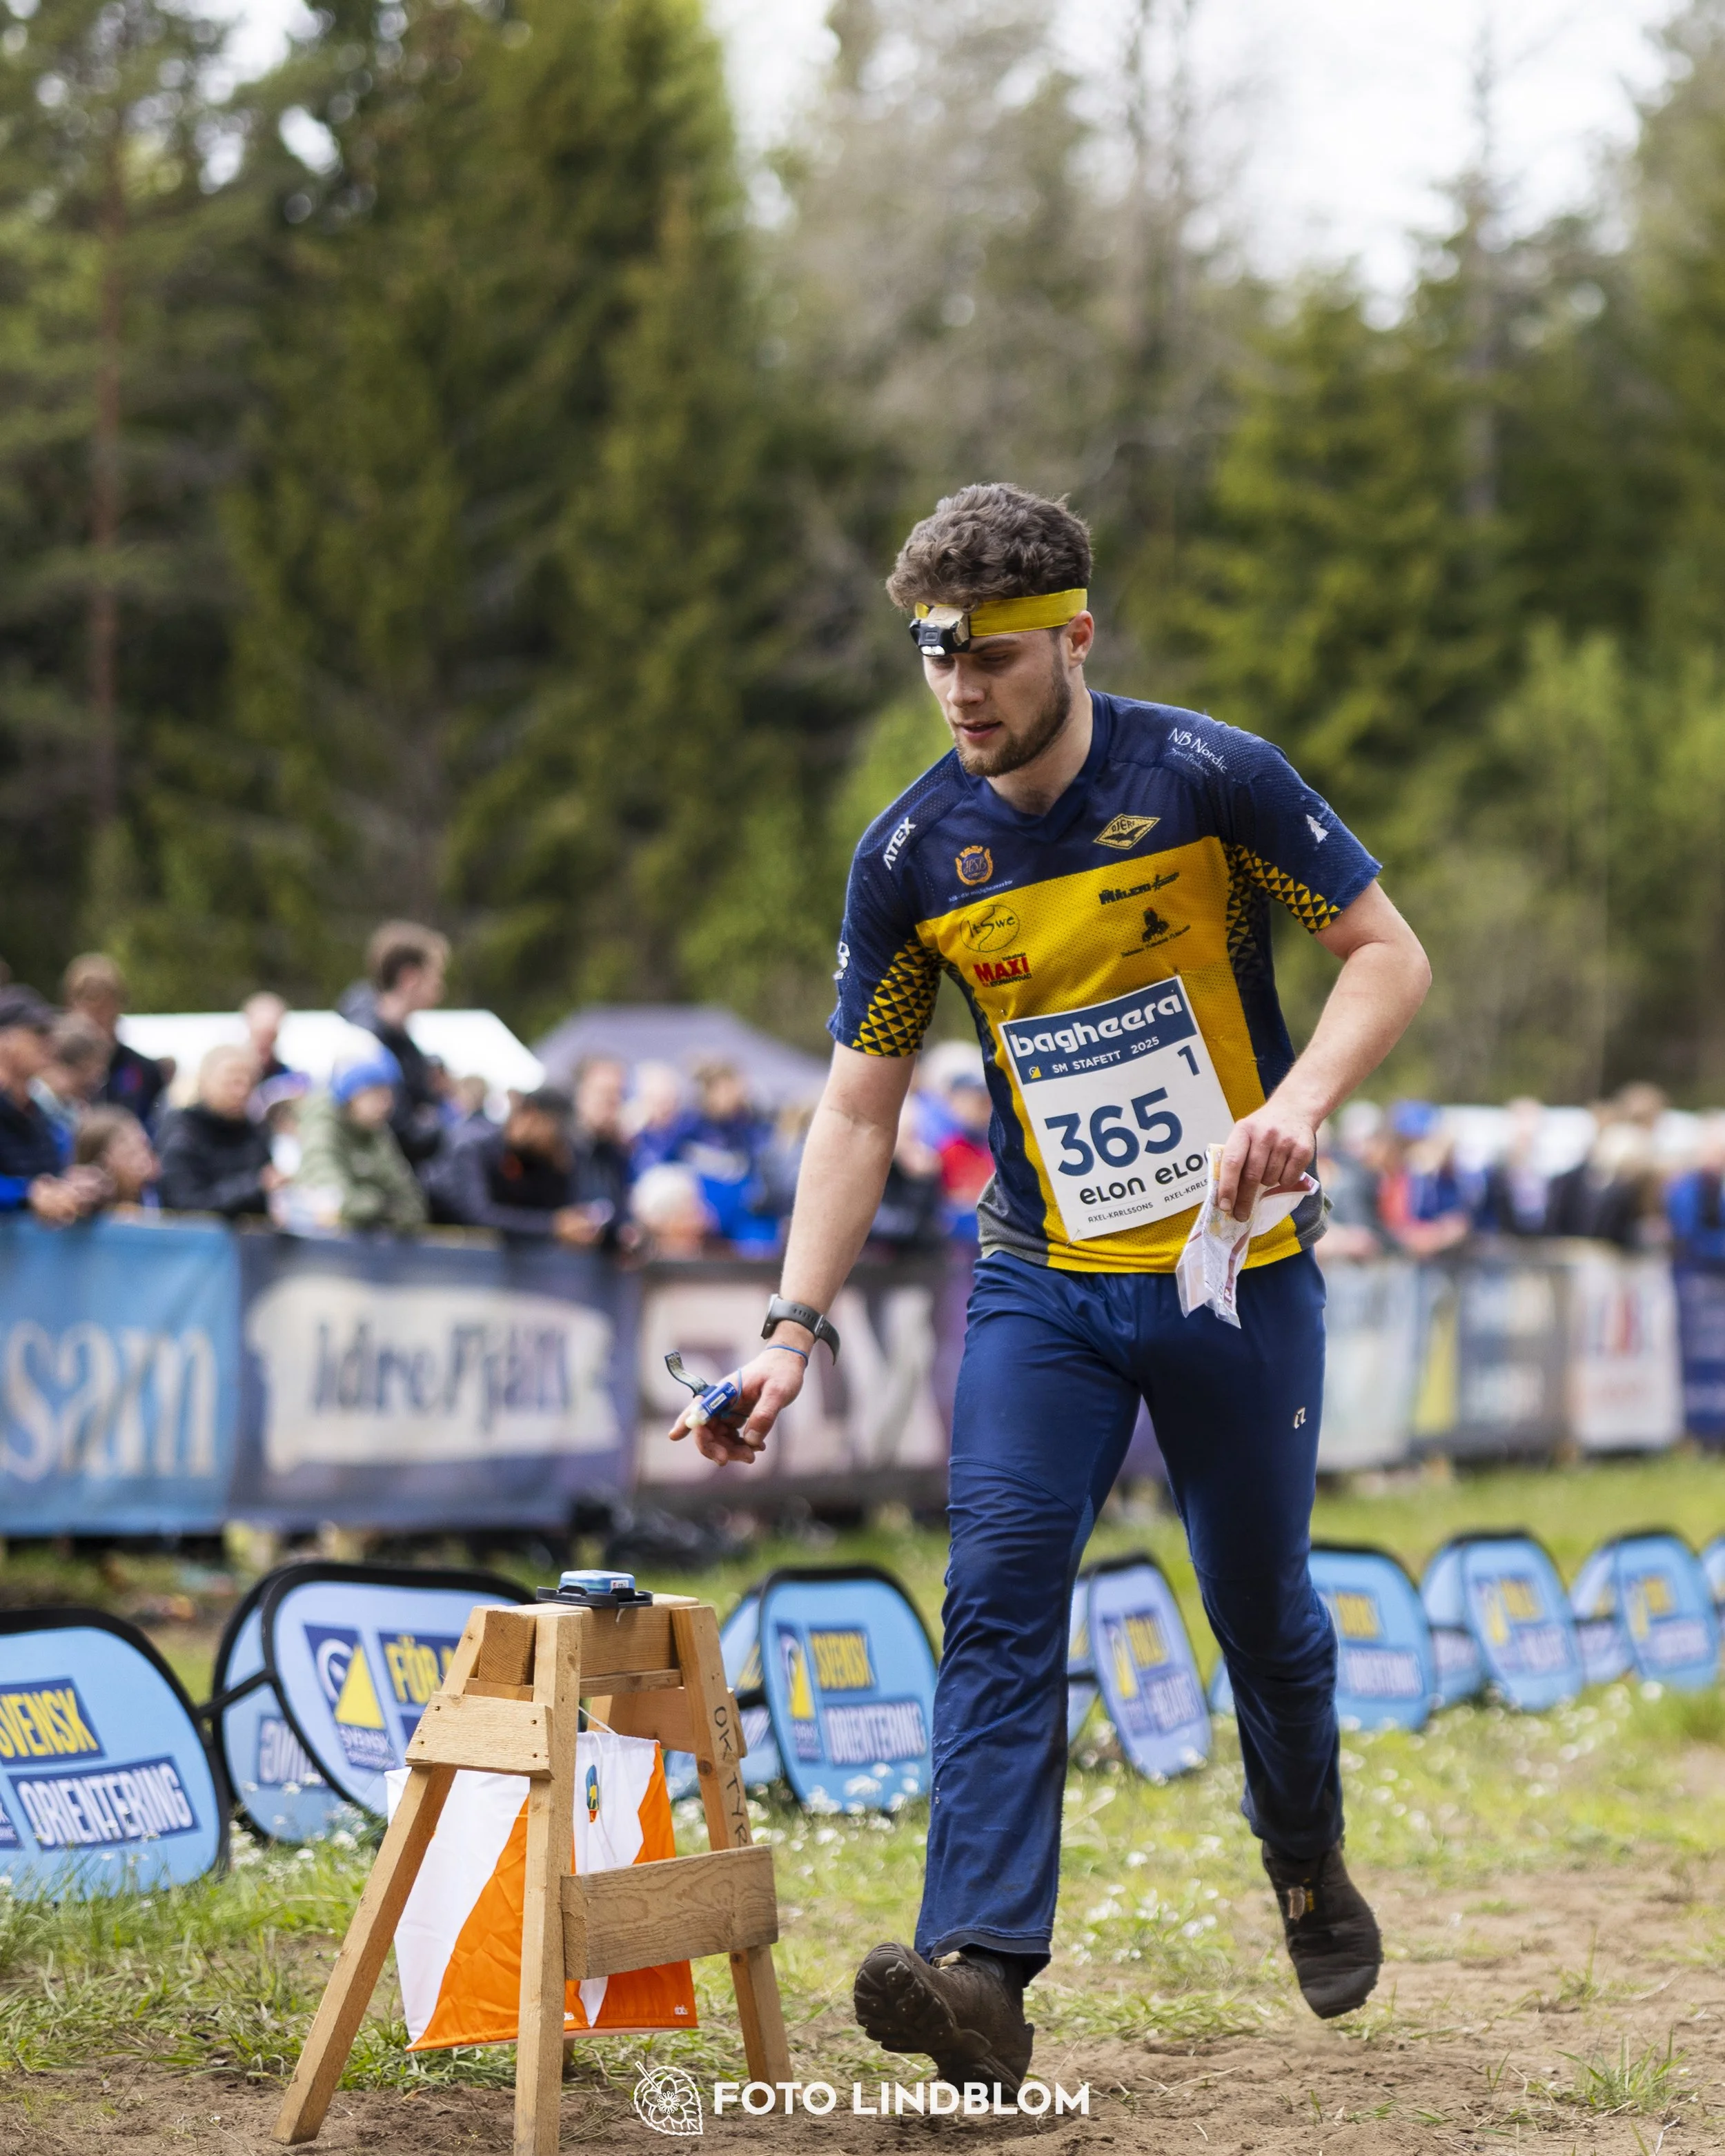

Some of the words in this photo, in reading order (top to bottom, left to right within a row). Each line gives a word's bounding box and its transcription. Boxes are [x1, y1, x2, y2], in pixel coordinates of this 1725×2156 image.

[1168, 727, 1193, 746] NB
[1190, 738, 1228, 773] Nordic
[973, 956, 1030, 982] MAXI
[1009, 994, 1183, 1058] bagheera
[1052, 1063, 1069, 1074] SM
[1074, 1050, 1121, 1071] STAFETT
[1130, 1036, 1160, 1054] 2025
[1177, 1045, 1201, 1076] 1
[1044, 1087, 1183, 1176] 365
[1088, 1202, 1154, 1223] AXEL-KARLSSONS
[1164, 1178, 1208, 1203] AXEL-KARLS
[714, 1706, 733, 1760] OK
[17, 1762, 193, 1846] ORIENTERING
